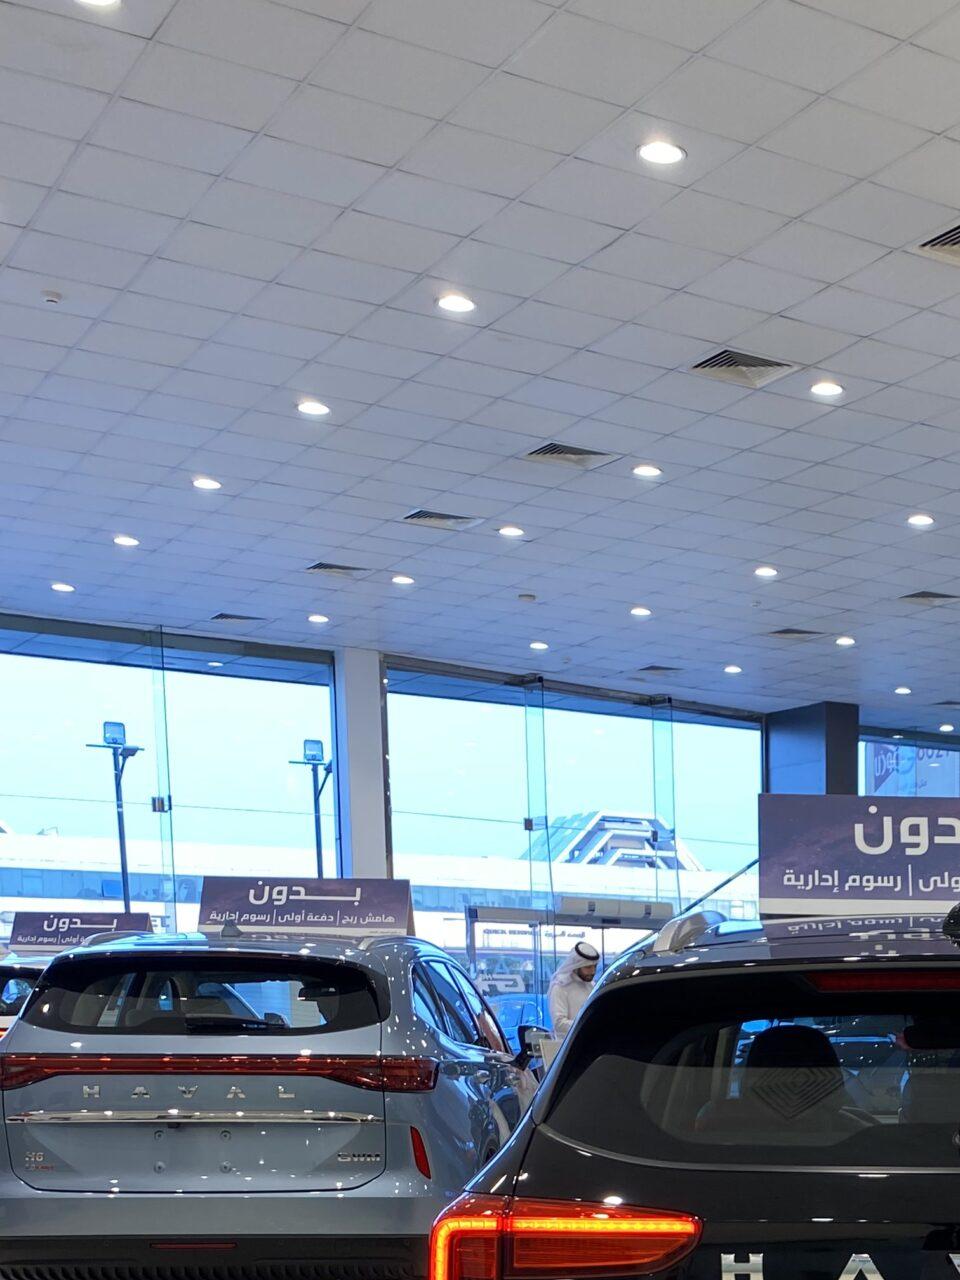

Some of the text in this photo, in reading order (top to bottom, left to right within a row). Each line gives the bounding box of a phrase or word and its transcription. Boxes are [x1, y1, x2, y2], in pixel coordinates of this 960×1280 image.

[783, 869, 840, 893] إدارية
[844, 874, 902, 892] رسوم
[249, 880, 361, 906] بدون
[43, 914, 117, 932] بدون
[240, 913, 270, 923] رسوم
[278, 910, 305, 924] أولى
[307, 912, 335, 922] دفعة
[342, 914, 358, 925] ربح
[360, 912, 396, 924] هامش
[82, 1085, 295, 1099] HAVAL
[336, 1151, 382, 1162] GWM
